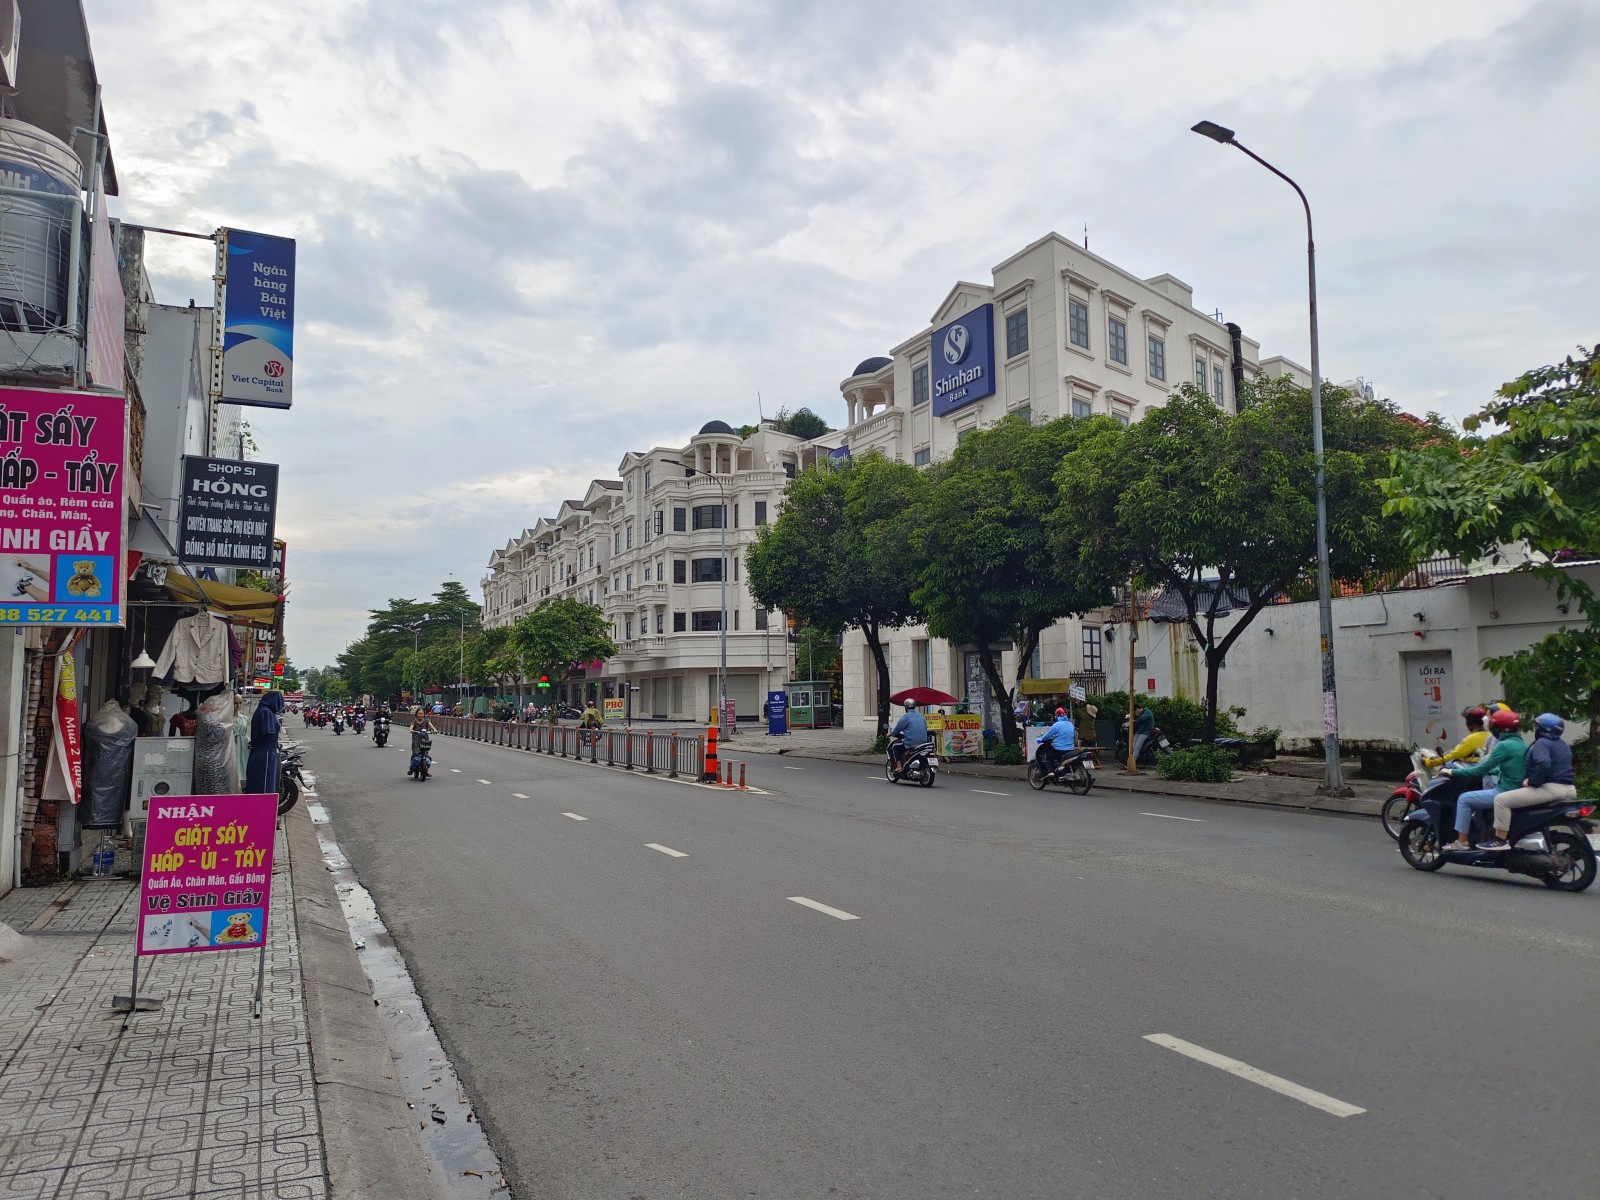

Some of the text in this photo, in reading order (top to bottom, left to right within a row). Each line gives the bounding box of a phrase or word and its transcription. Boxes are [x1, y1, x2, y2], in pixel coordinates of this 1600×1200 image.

[253, 262, 287, 276] Ngân
[254, 277, 287, 292] hàng
[261, 292, 286, 305] Bản
[260, 306, 286, 321] Việt
[232, 374, 284, 388] Viet Capital
[935, 365, 982, 397] Shinhan
[949, 388, 967, 402] Bank
[35, 404, 97, 448] SẤY
[64, 449, 118, 494] TẨY
[208, 463, 242, 474] SHOP
[192, 476, 268, 498] HỒNG
[38, 497, 57, 507] áo,
[60, 498, 88, 508] Rèm
[92, 498, 115, 509] cửa
[22, 509, 57, 520] Chăn,
[61, 510, 91, 521] Màn,
[187, 514, 206, 531] CHUYÊN
[207, 517, 222, 533] TRANG
[0, 524, 110, 551] NH GIẦY
[185, 536, 267, 563] ĐỒNG HỒ MẮT KÍNH HIỆU
[28, 609, 68, 621] 527
[75, 609, 112, 622] 441
[1420, 664, 1445, 675] LỐI RA
[1424, 677, 1441, 685] EXIT
[944, 719, 957, 730] Xôi
[959, 719, 980, 731] Chiên
[64, 716, 76, 745] Mua
[70, 748, 80, 756] 2
[157, 803, 215, 821] NHẬN
[174, 820, 249, 850] GIẶT SẤY
[150, 846, 184, 873] HẤP
[201, 846, 217, 870] ỦI
[234, 842, 267, 868] TẨY
[170, 874, 184, 889] Áo,
[185, 876, 206, 887] Chăn
[207, 874, 227, 886] Màn,
[229, 871, 244, 884] Gấu
[245, 873, 266, 884] Bông
[147, 888, 263, 912] Vệ Sinh Giầy
